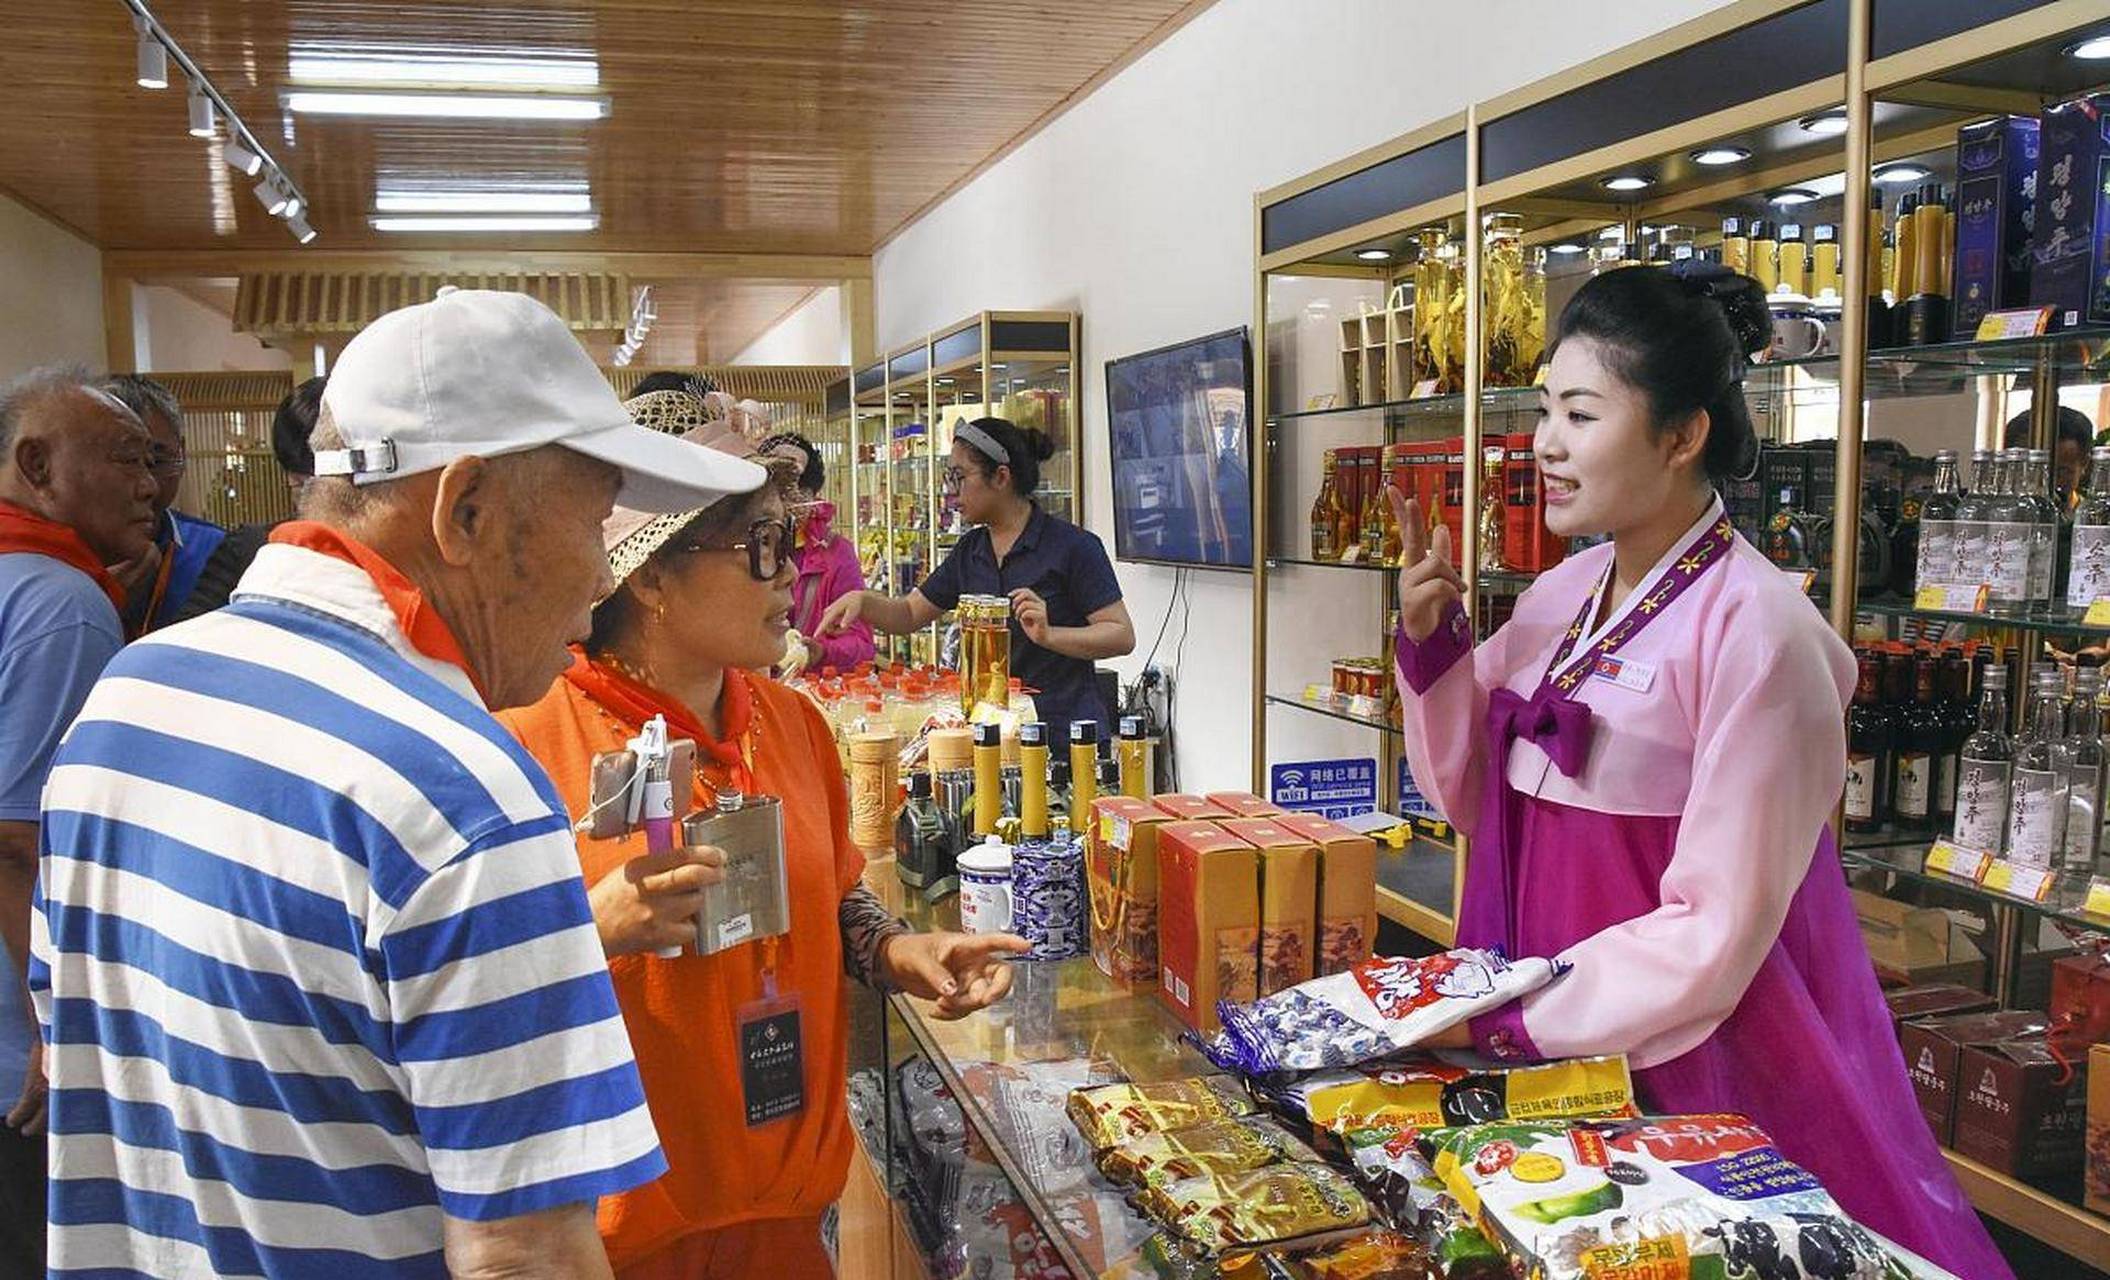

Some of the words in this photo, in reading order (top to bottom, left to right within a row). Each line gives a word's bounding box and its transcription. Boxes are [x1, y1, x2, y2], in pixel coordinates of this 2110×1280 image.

[1310, 767, 1371, 783] 网络已覆盖
